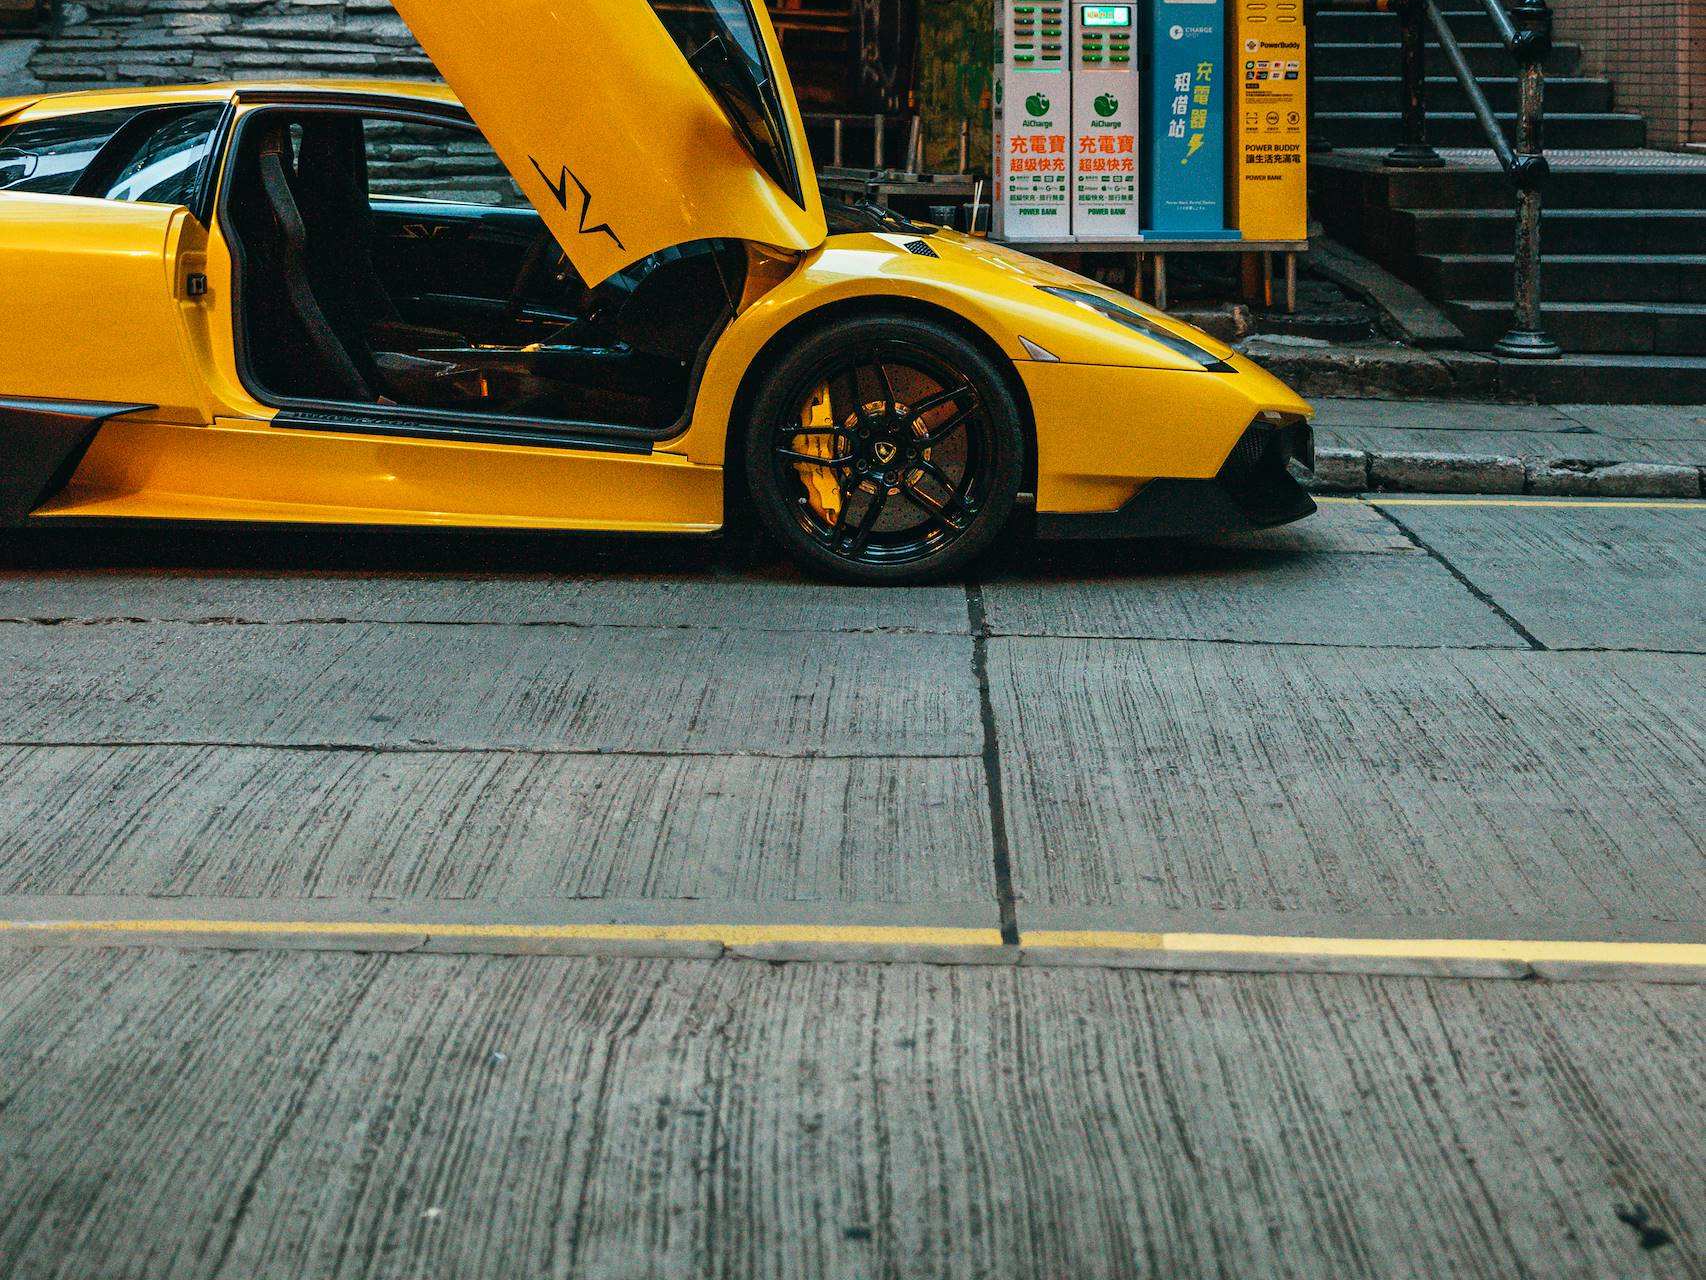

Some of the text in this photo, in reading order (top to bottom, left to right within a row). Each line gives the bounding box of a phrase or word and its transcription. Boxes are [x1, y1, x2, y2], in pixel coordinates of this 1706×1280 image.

[1260, 41, 1300, 49] PowerBuddy
[1168, 72, 1191, 138] 租借站
[1022, 120, 1053, 129] AiCharge
[1091, 120, 1121, 129] AiCharge
[1010, 135, 1066, 154] 充電寶
[1079, 135, 1134, 154] 充電寶
[1245, 144, 1300, 152] POWER BUDDY
[1019, 208, 1057, 216] POWER BANK
[1088, 208, 1126, 216] POWER BANK
